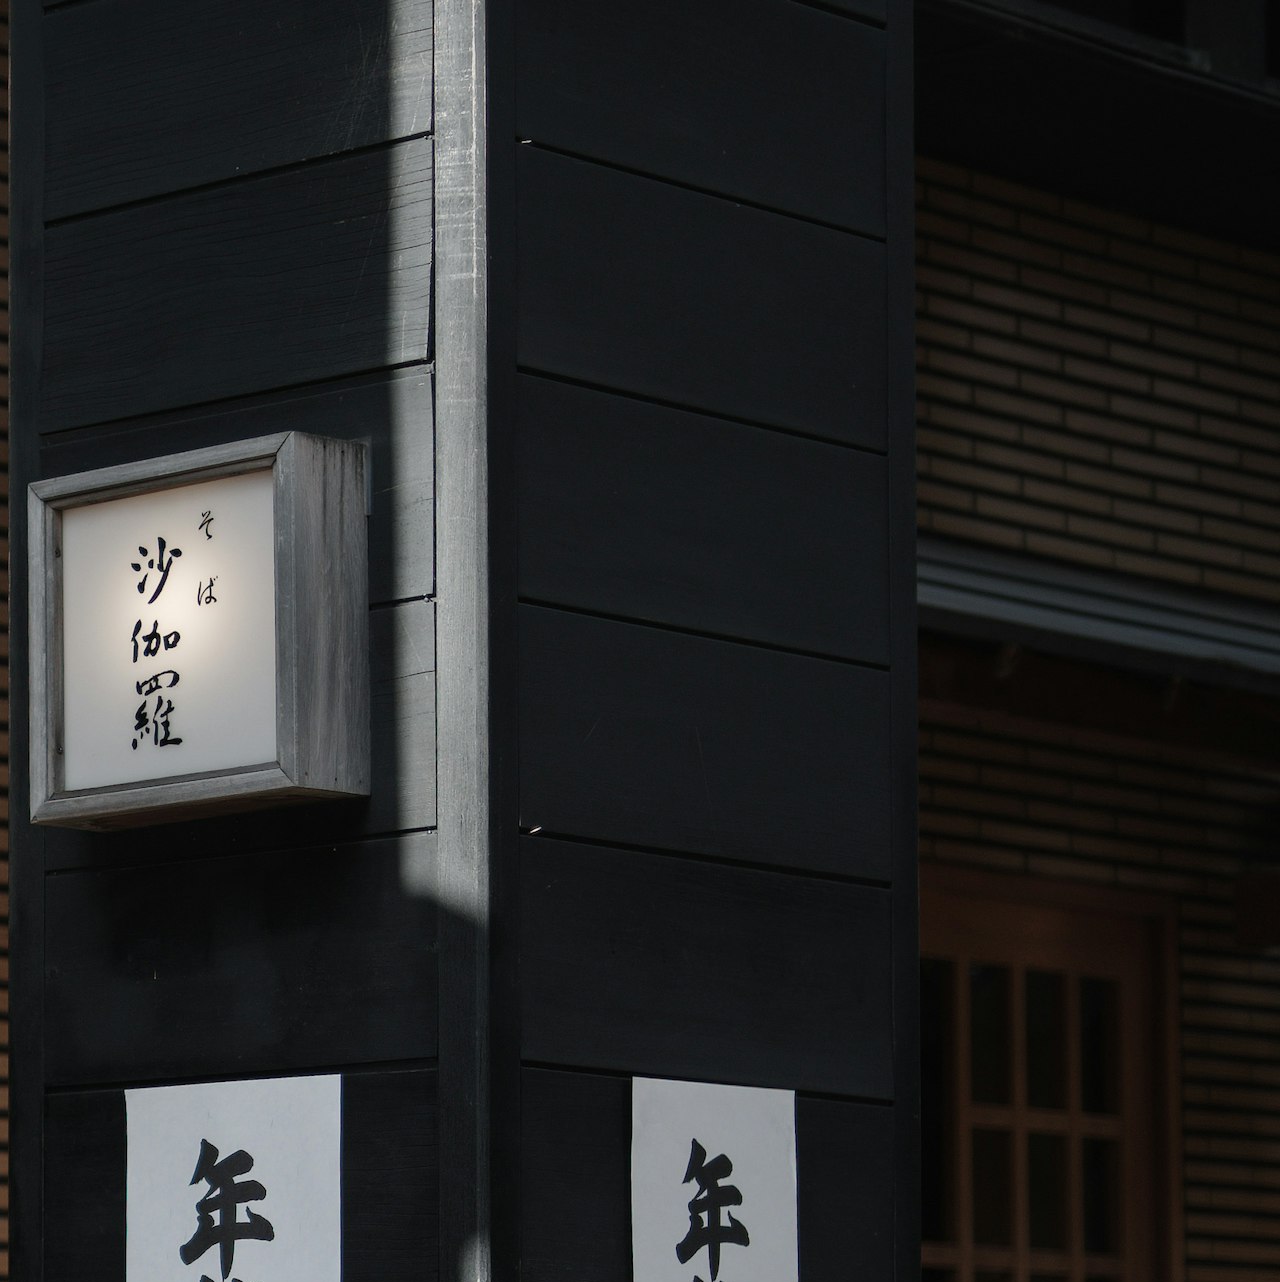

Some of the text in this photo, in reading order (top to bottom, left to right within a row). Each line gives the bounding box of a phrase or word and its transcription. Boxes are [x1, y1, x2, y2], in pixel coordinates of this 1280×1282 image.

[198, 510, 218, 606] そば
[131, 536, 183, 750] 沙伽羅
